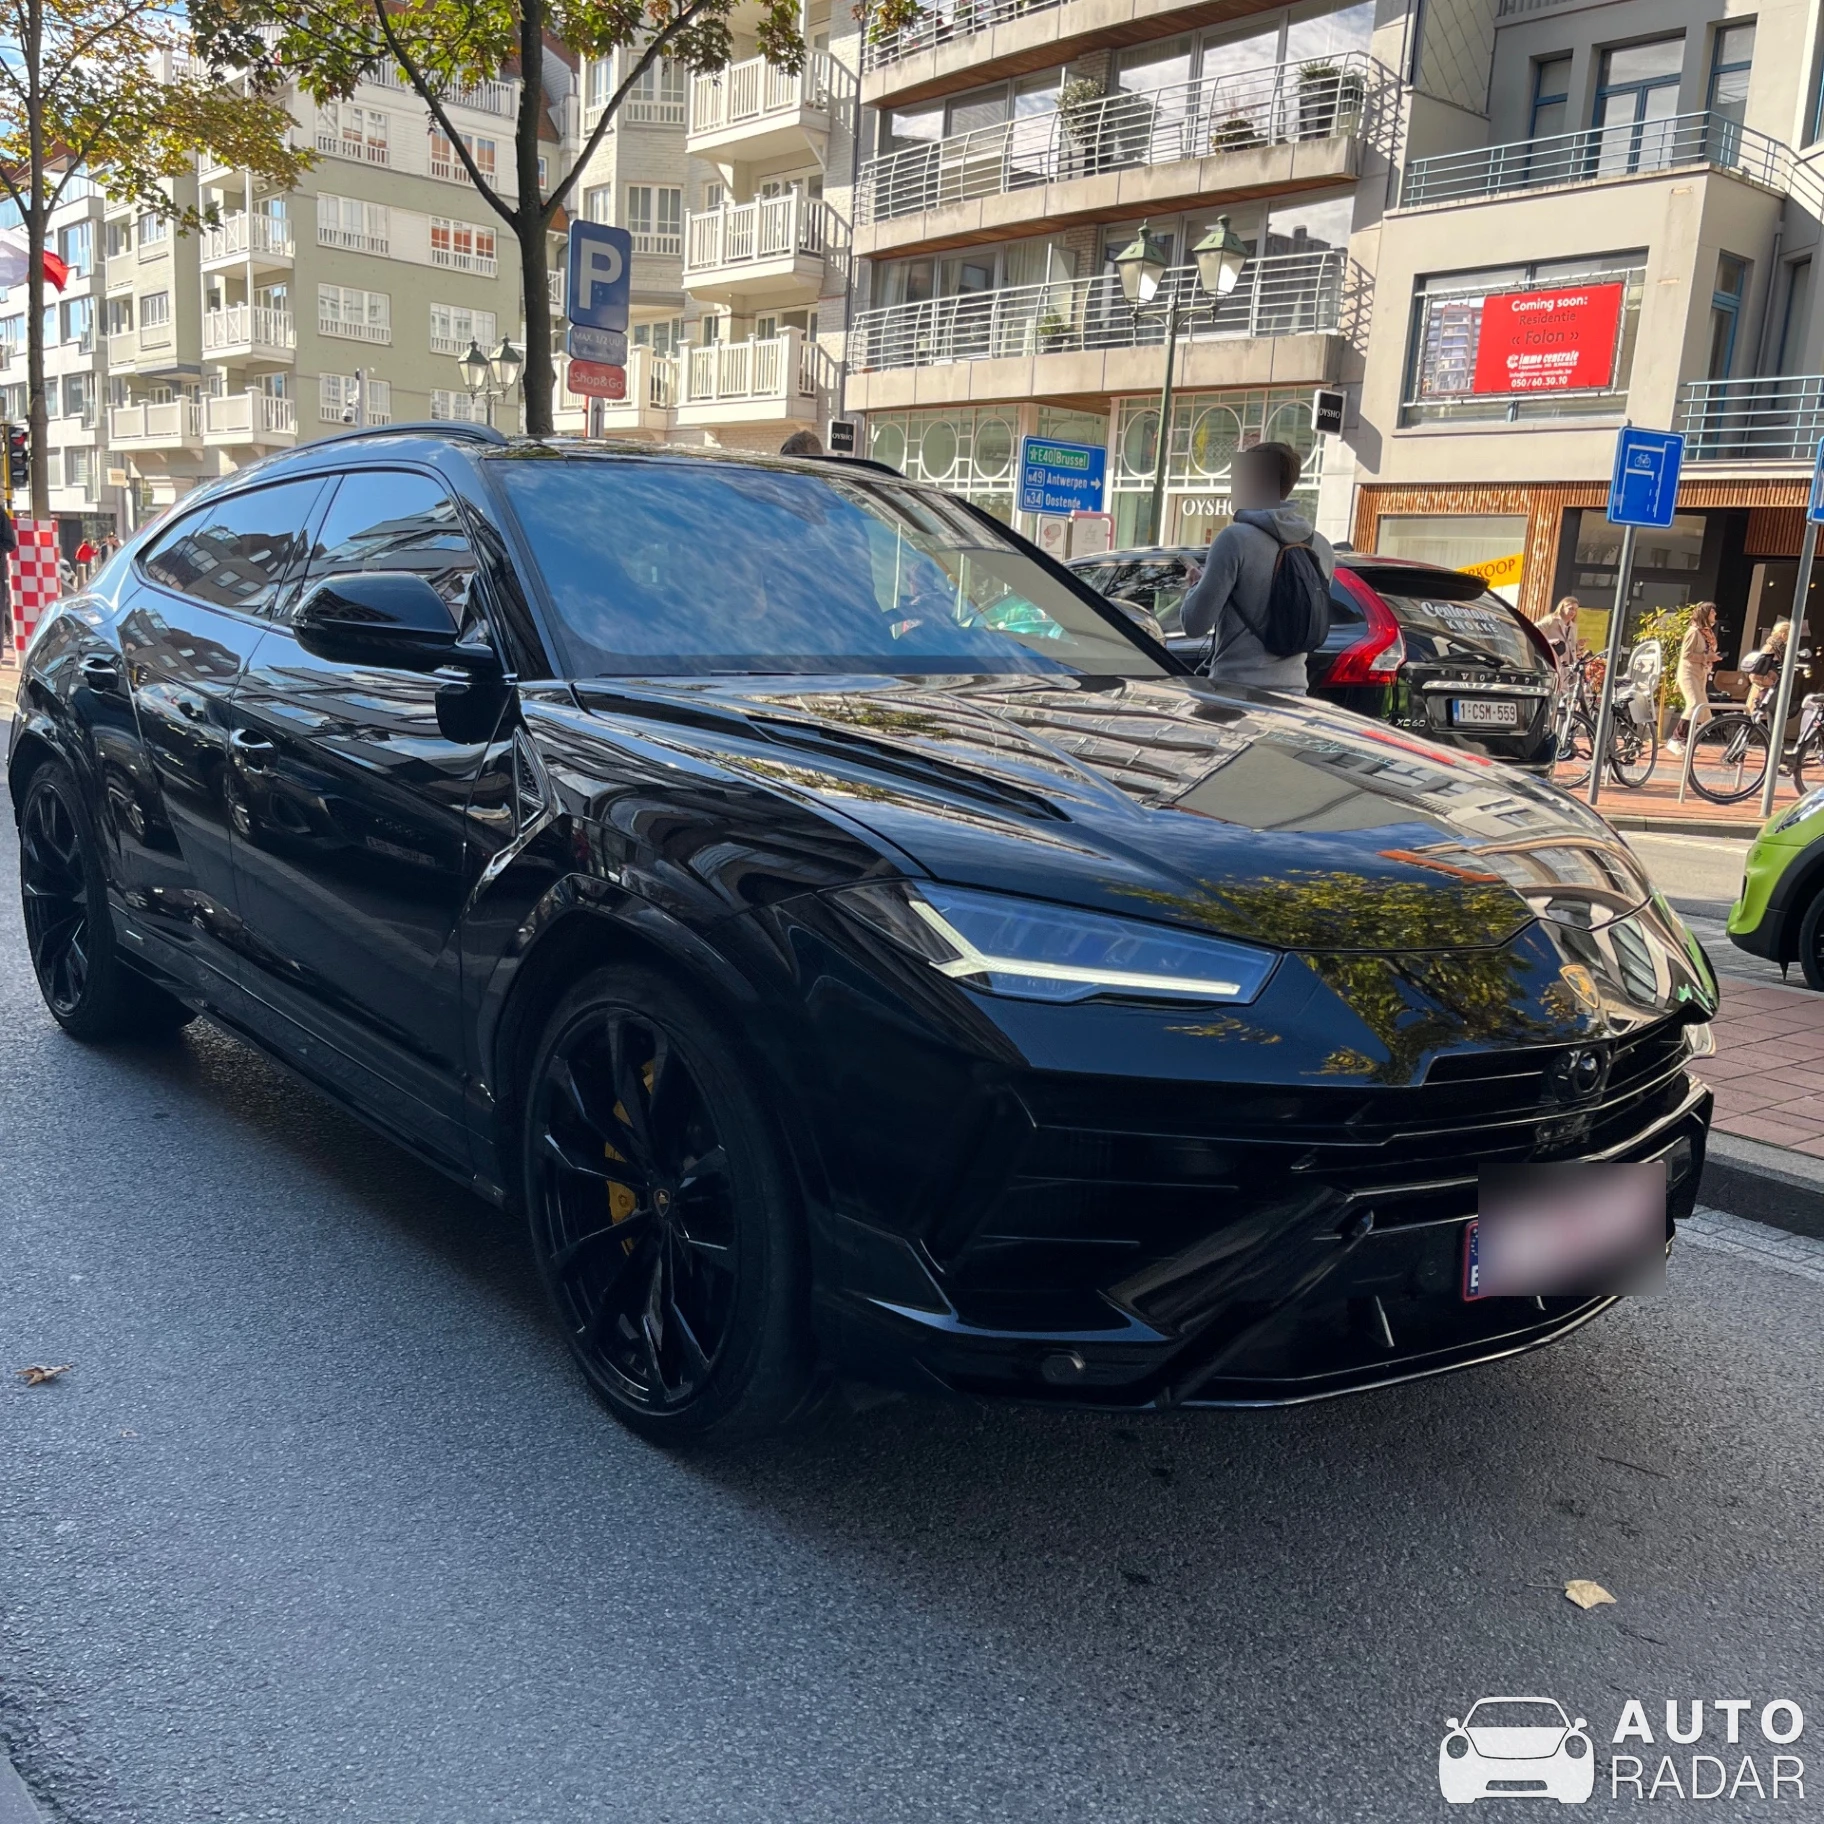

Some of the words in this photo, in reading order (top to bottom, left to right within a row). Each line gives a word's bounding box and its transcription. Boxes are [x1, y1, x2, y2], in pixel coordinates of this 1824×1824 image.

[578, 238, 622, 310] P
[1511, 297, 1554, 312] Coming
[1557, 296, 1588, 308] soon:
[1519, 310, 1576, 326] Residentie
[595, 335, 608, 345] 1/2
[1525, 329, 1565, 344] Folon
[1543, 350, 1579, 363] centrale
[574, 371, 623, 390] Shop&Go
[1318, 407, 1340, 419] OYSHO
[832, 433, 853, 442] OYSHO
[1038, 449, 1054, 462] E40
[1056, 451, 1087, 467] Brussel
[1046, 472, 1088, 490] Antwerpen
[1045, 493, 1081, 509] Oostende
[1420, 601, 1499, 622] Centenaire
[1445, 620, 1499, 633] KNOKKE
[1460, 672, 1530, 684] VOLVO
